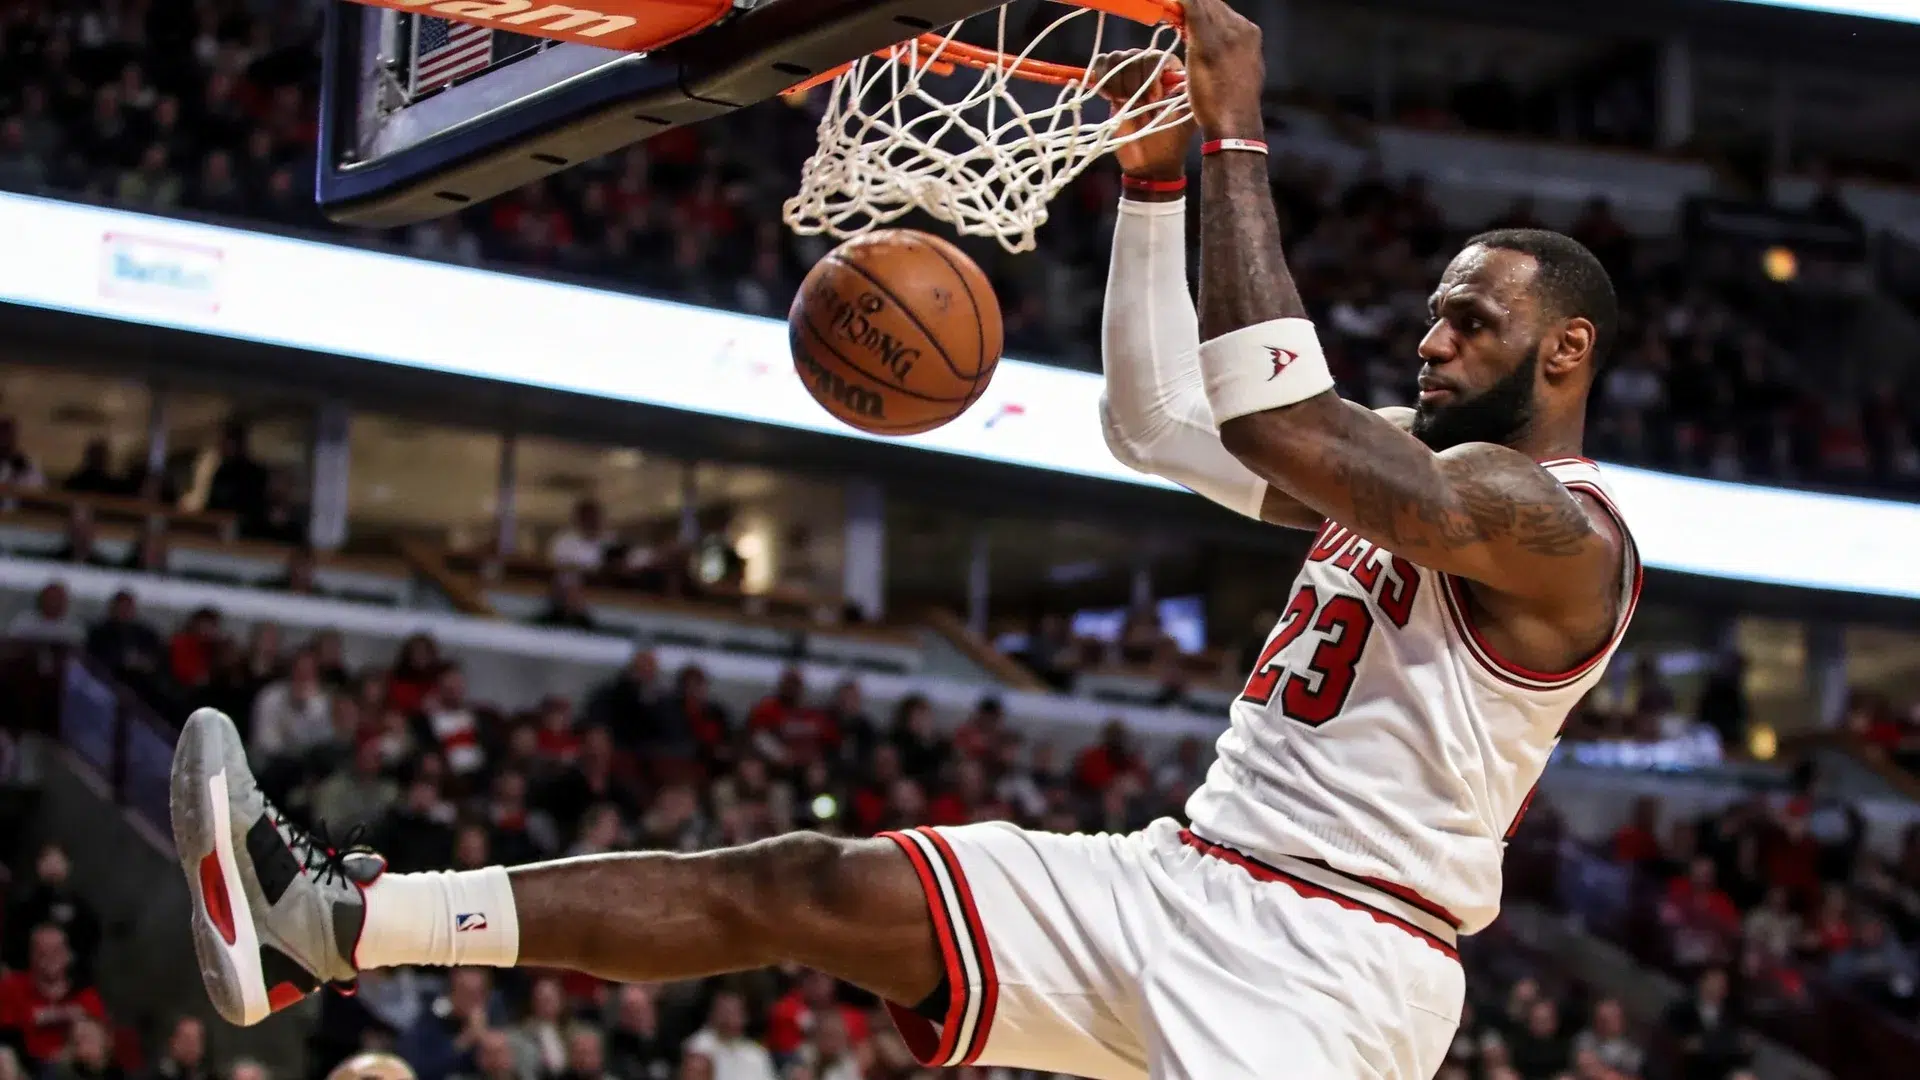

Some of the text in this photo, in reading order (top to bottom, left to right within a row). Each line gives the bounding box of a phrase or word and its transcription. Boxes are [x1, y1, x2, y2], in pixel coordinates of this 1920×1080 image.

[396, 0, 638, 38] am
[1307, 518, 1422, 630] ULLS
[1239, 585, 1375, 729] 23
